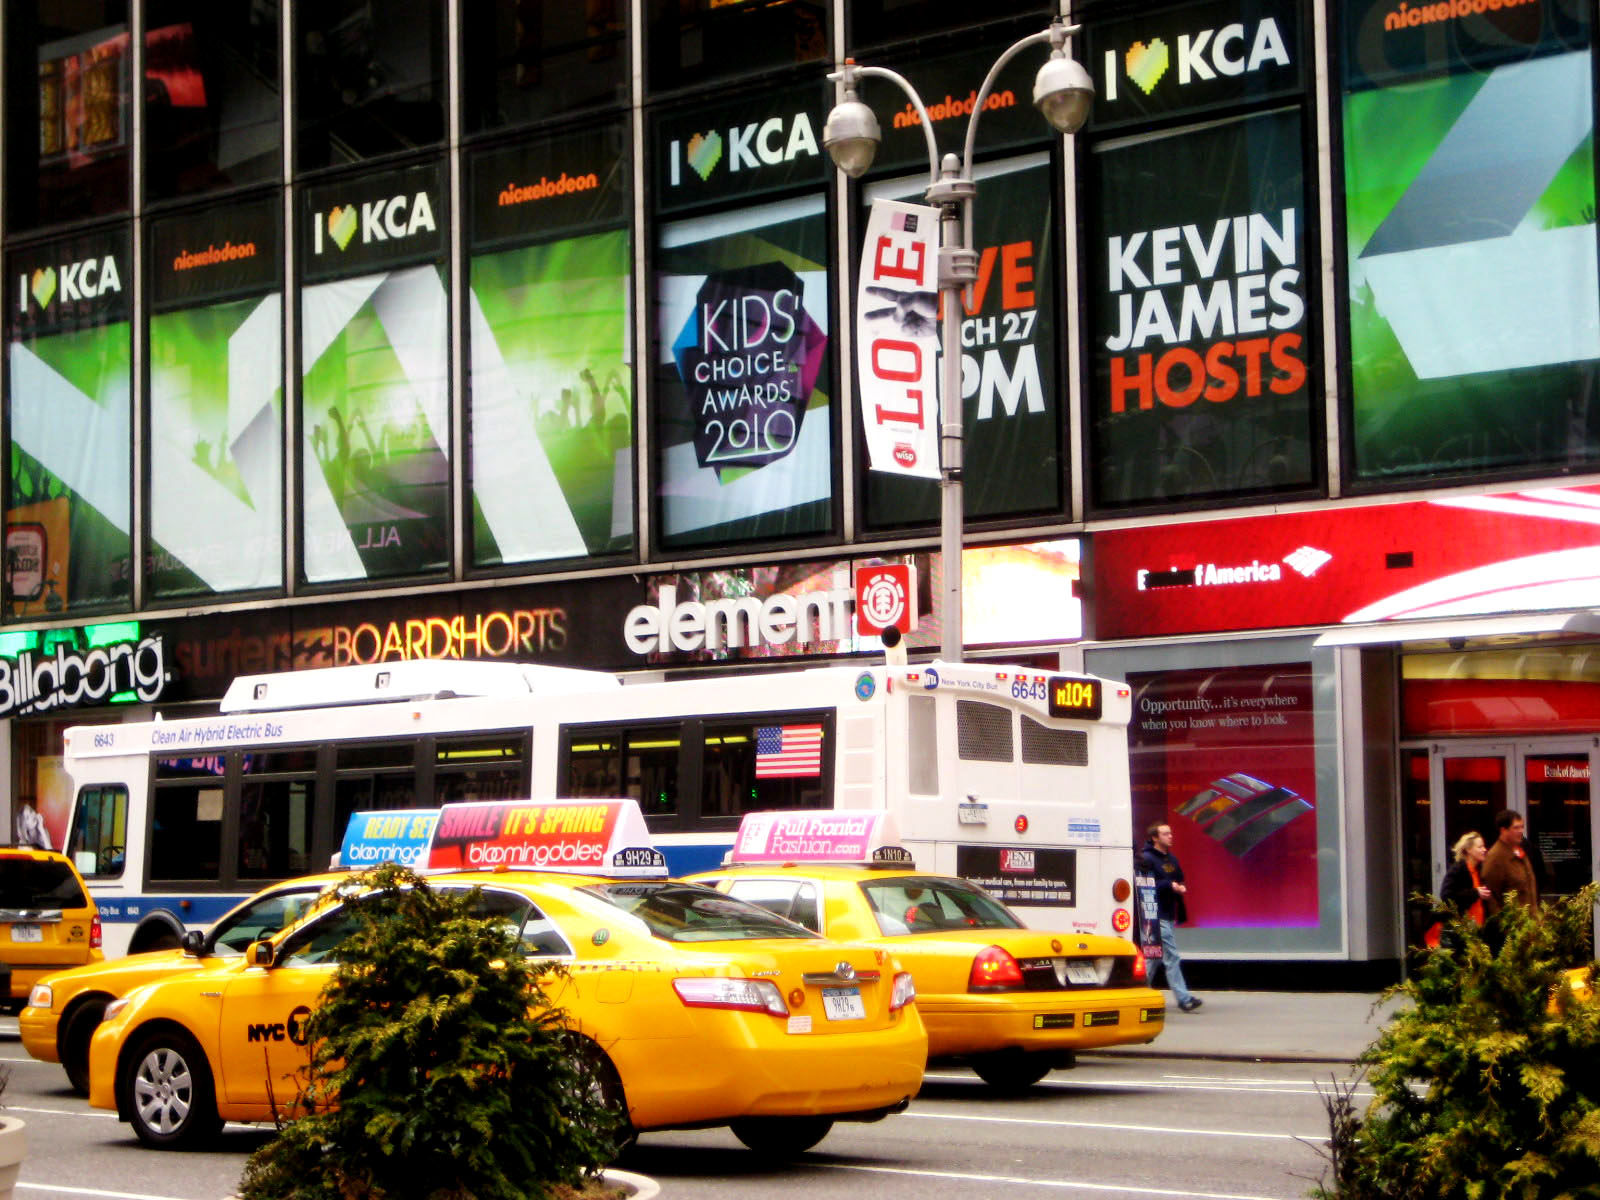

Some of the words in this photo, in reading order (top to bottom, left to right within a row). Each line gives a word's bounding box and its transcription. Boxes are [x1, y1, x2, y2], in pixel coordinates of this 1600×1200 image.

[1384, 0, 1538, 31] nickelode
[1104, 49, 1117, 101] I
[1176, 17, 1290, 86] KCA
[892, 89, 1016, 129] nicelodon
[669, 139, 681, 187] I
[728, 112, 819, 173] KCA
[498, 171, 600, 207] nickelodeon
[314, 212, 324, 254] I
[361, 191, 437, 244] KCA
[173, 241, 256, 271] nickelodeon
[1108, 207, 1296, 292] KEVIN
[19, 273, 28, 313] I
[59, 255, 122, 303] KCA
[938, 241, 1035, 321] VE
[1002, 310, 1038, 342] 27
[1105, 268, 1305, 352] JAMES
[694, 350, 787, 383] CHOICE
[1109, 332, 1307, 414] HOSTS
[701, 380, 791, 415] AWARDS
[704, 409, 797, 462] 2010
[1204, 560, 1281, 586] America
[623, 568, 857, 656] element
[334, 606, 568, 666] BOARDSHORTS
[957, 680, 971, 688] York
[972, 681, 985, 690] City
[1011, 681, 1047, 701] 6643
[1240, 693, 1298, 709] everywhere
[151, 728, 177, 745] Clean
[178, 727, 192, 744] Air
[193, 725, 227, 746] Hybrid
[227, 723, 263, 741] Electric
[264, 722, 283, 739] Bus
[1141, 718, 1168, 731] when
[1169, 720, 1187, 732] you
[1189, 716, 1217, 729] know
[1218, 715, 1249, 728] where
[1251, 716, 1262, 726] to
[94, 733, 114, 748] 6643
[363, 816, 409, 839] READY
[440, 805, 500, 838] SMILE
[504, 805, 537, 835] IT'S
[539, 804, 607, 834] SPRING
[774, 818, 809, 836] Full
[807, 817, 867, 836] Frontal
[349, 842, 432, 864] bloomingd
[625, 850, 651, 866] 9H29
[247, 1023, 286, 1042] NYC
